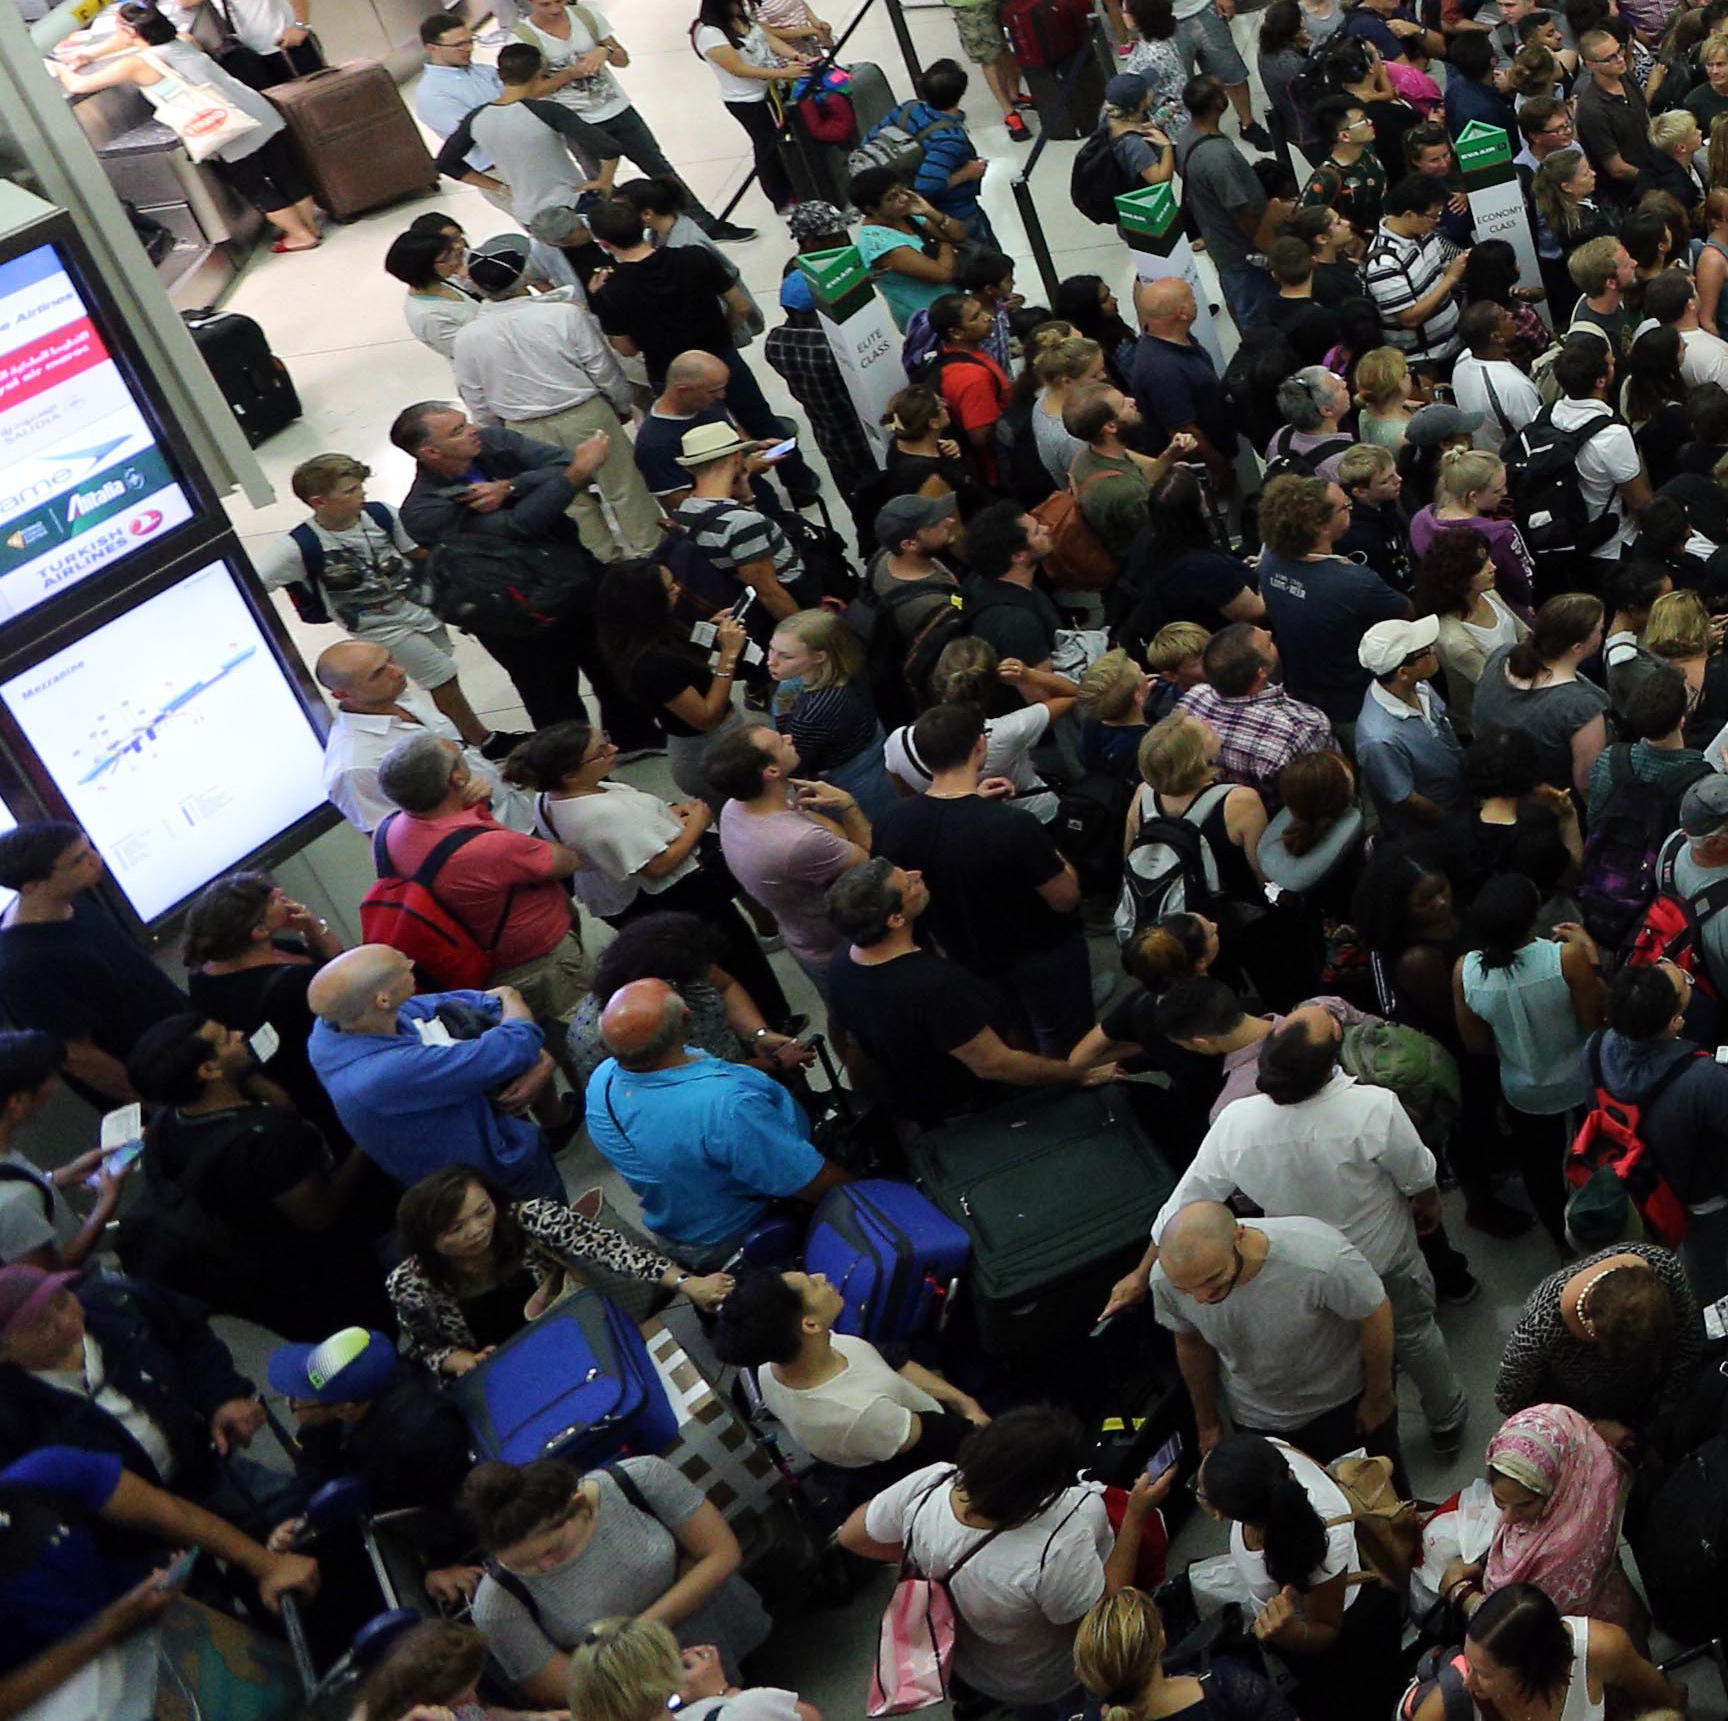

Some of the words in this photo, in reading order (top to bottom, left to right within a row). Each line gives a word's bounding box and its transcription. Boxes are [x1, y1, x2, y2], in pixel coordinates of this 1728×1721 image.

[1476, 205, 1523, 225] ECONOMY
[1489, 219, 1517, 234] CLASS
[16, 292, 74, 325] Airlines
[857, 327, 883, 354] ELITE
[860, 339, 891, 369] CLASS
[22, 367, 43, 382] air
[66, 479, 127, 522] Alitalia
[38, 526, 124, 579] TURKISH
[43, 536, 128, 589] AIRLINES
[21, 660, 86, 700] Mezzanine
